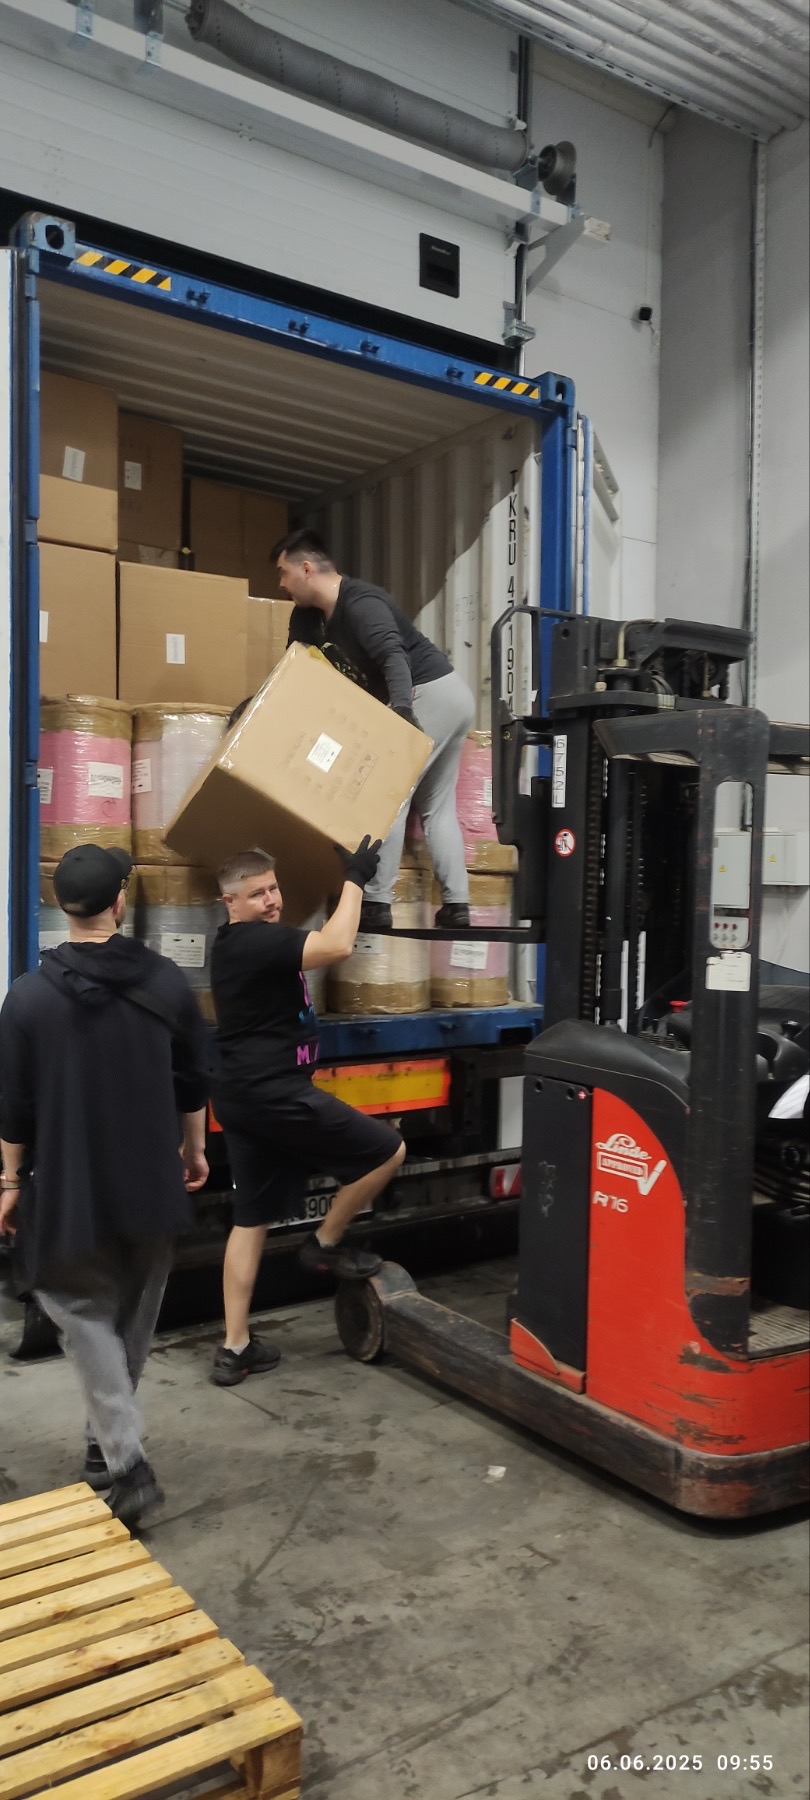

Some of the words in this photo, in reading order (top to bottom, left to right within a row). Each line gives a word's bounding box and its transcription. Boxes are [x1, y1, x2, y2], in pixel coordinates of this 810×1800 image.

[507, 470, 518, 566] TKRU
[595, 1133, 652, 1160] Linde
[601, 1157, 644, 1177] APPROVED
